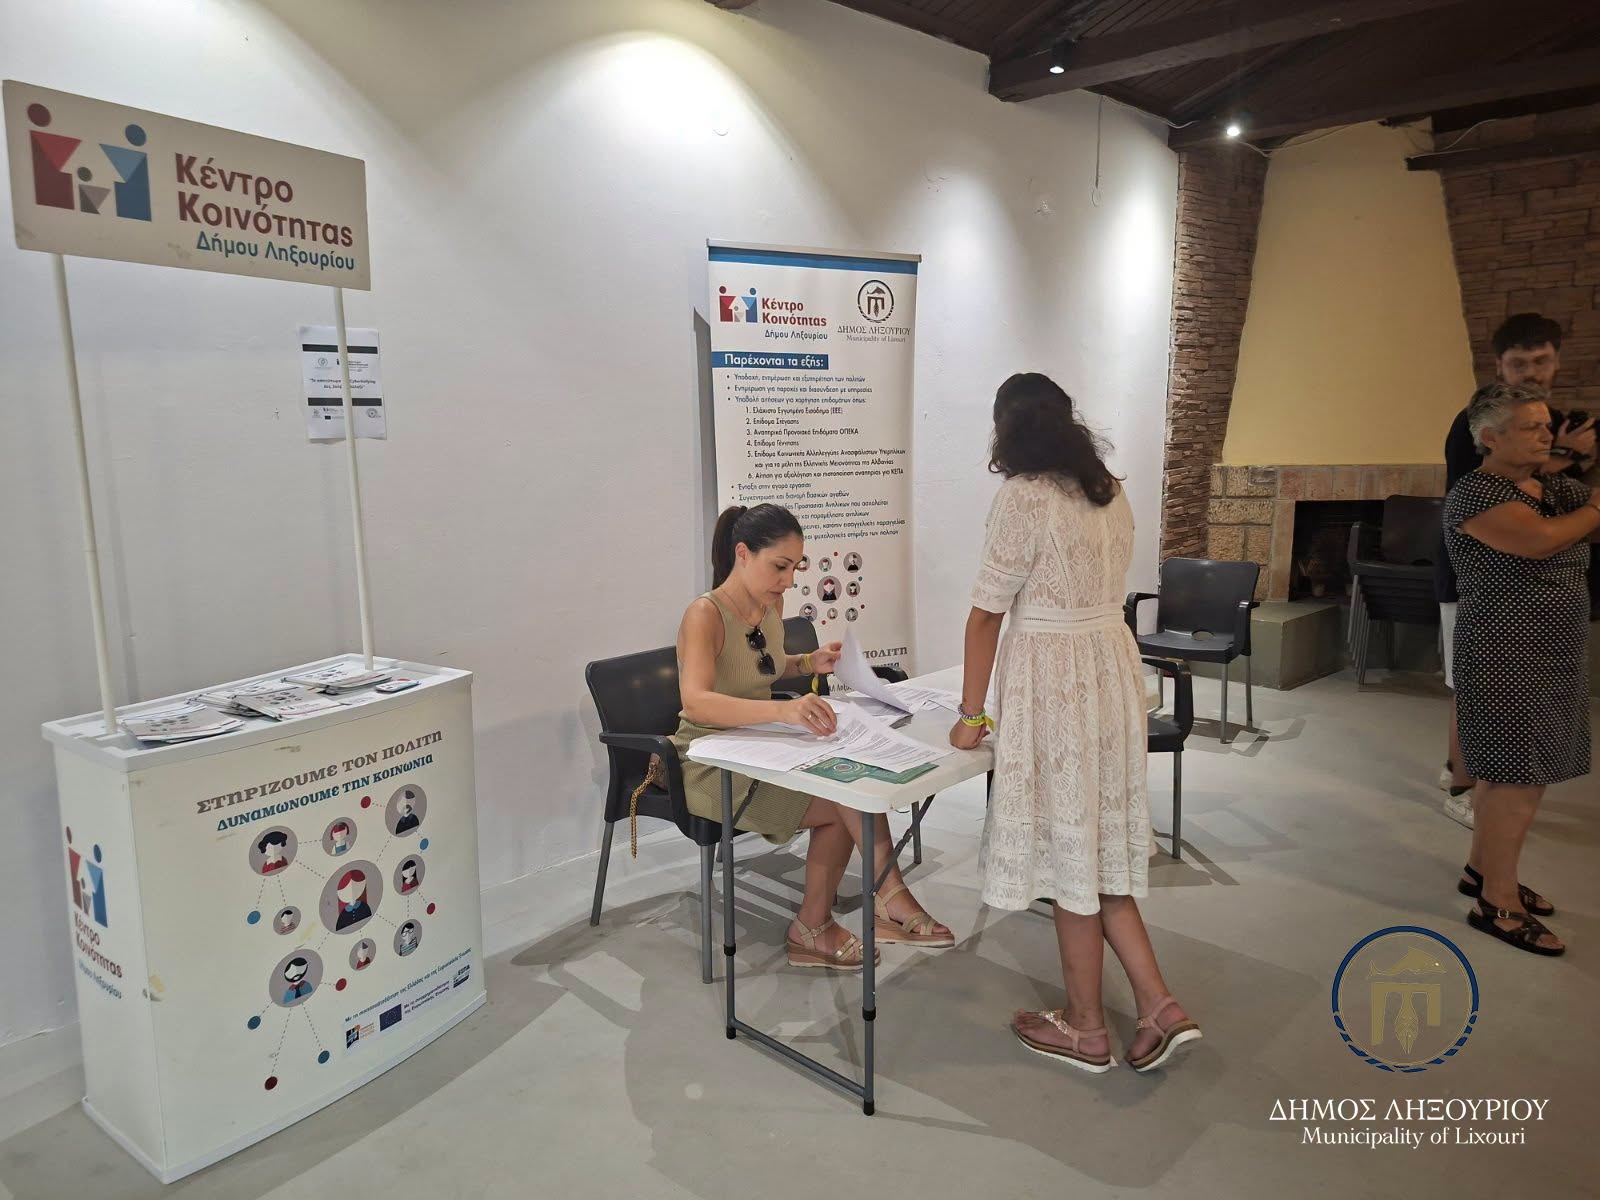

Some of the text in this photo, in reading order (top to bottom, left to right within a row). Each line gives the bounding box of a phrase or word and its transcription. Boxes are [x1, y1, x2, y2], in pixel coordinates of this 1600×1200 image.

[174, 152, 293, 205] Κέντρο
[177, 190, 352, 247] Κοινότητας
[196, 231, 355, 271] Δήμου Ληξουρίου
[762, 298, 803, 313] Κέντρο
[763, 313, 827, 326] Κοινότητας
[765, 330, 827, 341] Δήμου Ληξουρίου
[838, 326, 911, 335] ΔΗΜΟΣ ΛΗΞΟΥΡΙΟΥ
[725, 354, 824, 369] Παρέχονται τα εξής:
[735, 373, 760, 382] Υποδοχή,
[735, 385, 765, 393] Ενημέρωση
[806, 407, 829, 415] Εισόδημα
[754, 418, 774, 426] Επίδομα
[776, 418, 799, 426] Στέγασης
[754, 440, 775, 448] Επίδομα
[197, 730, 442, 814] ΣΤΗΡΙΖΟΥΜΕ ΤΟΝ ΠΟΛΙΤΗ
[343, 774, 370, 793] ΤΗΝ
[372, 753, 433, 785] ΚΟΙΝΩΝΙΑ
[74, 910, 100, 946] Κέντρο
[76, 931, 123, 978] Κοινότητας
